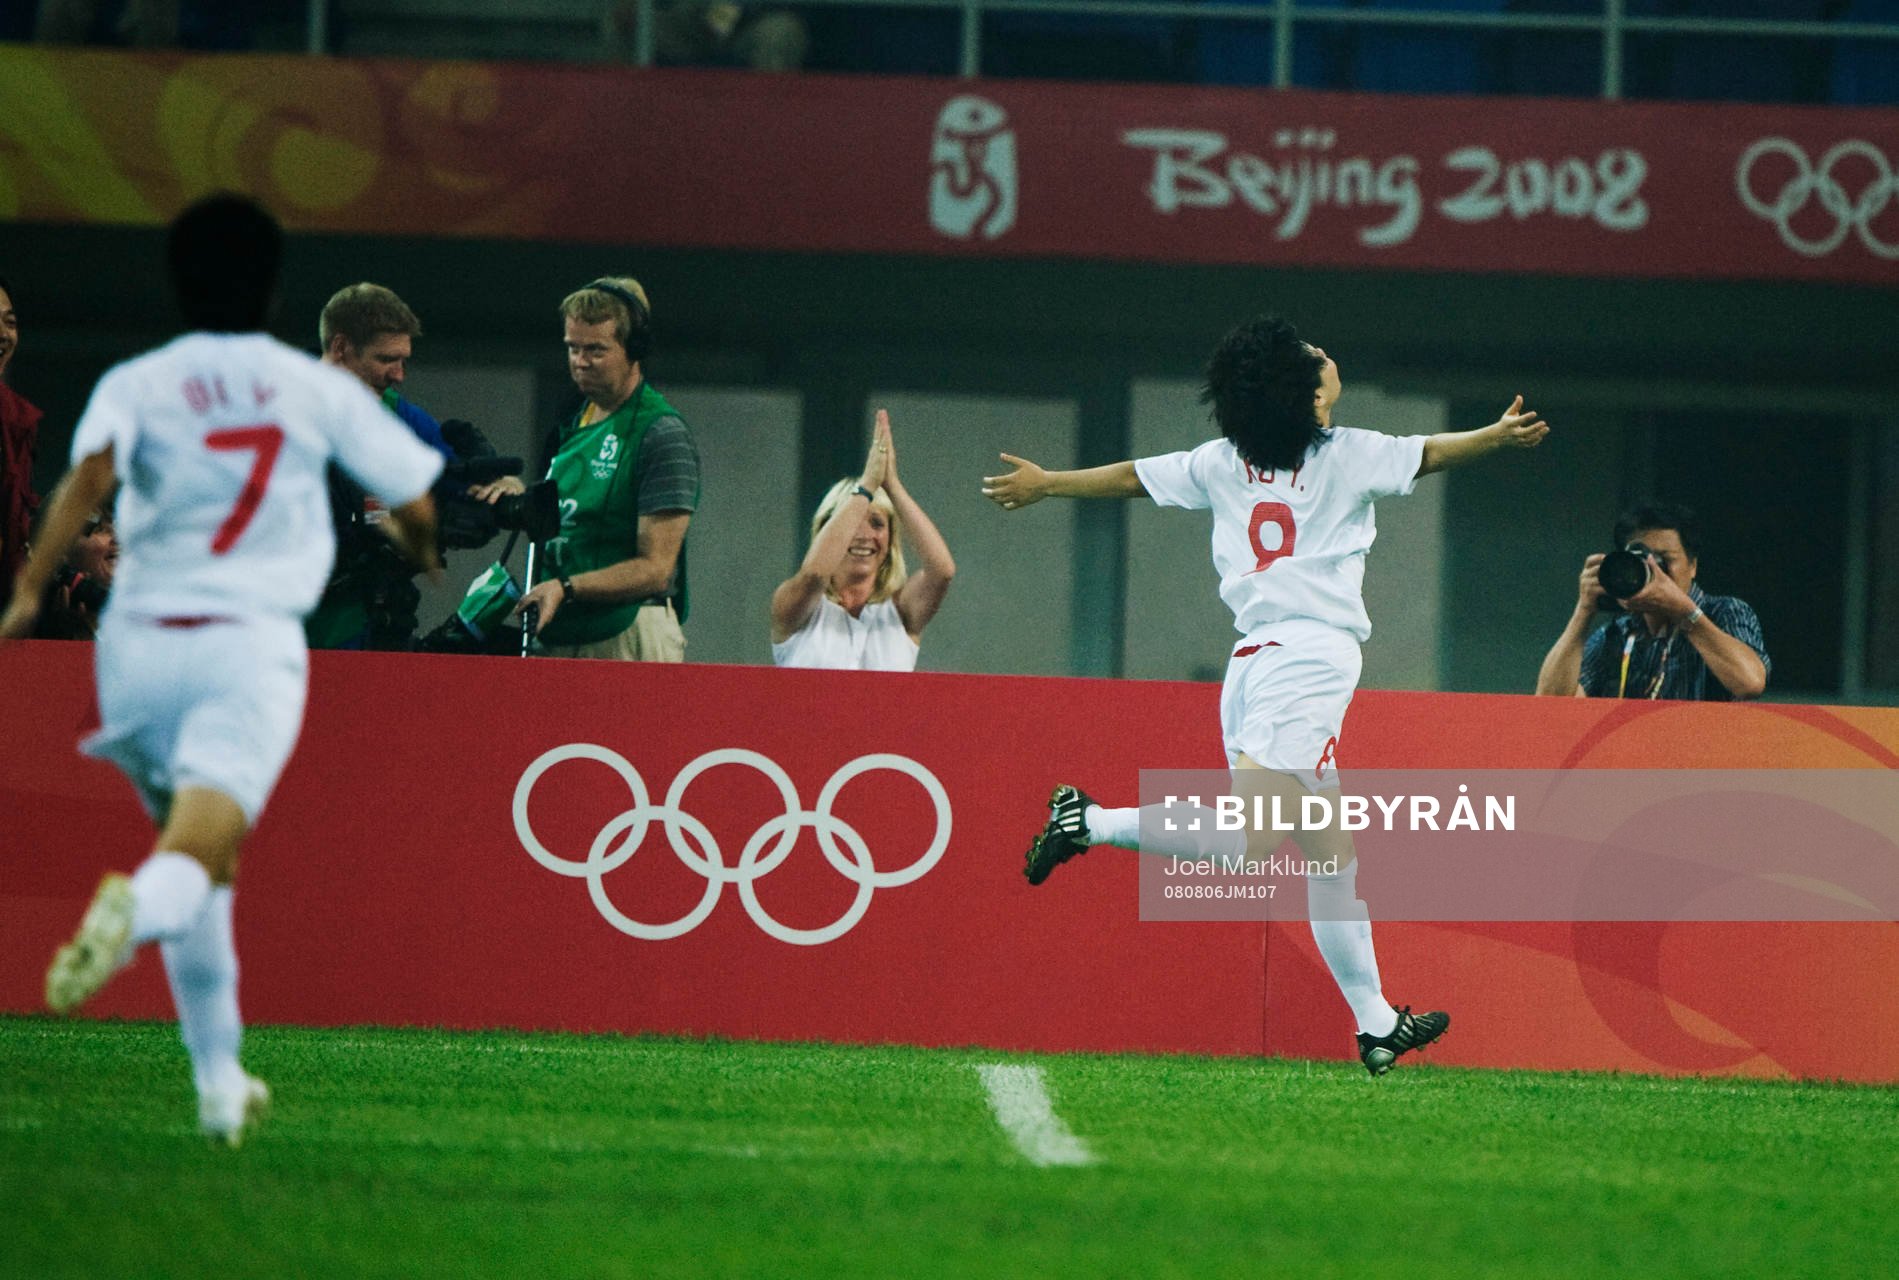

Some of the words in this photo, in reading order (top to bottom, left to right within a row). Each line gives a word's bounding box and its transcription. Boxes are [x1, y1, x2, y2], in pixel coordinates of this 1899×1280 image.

[1122, 128, 1421, 245] Beijing
[1441, 148, 1650, 230] 2008
[204, 424, 286, 556] 7
